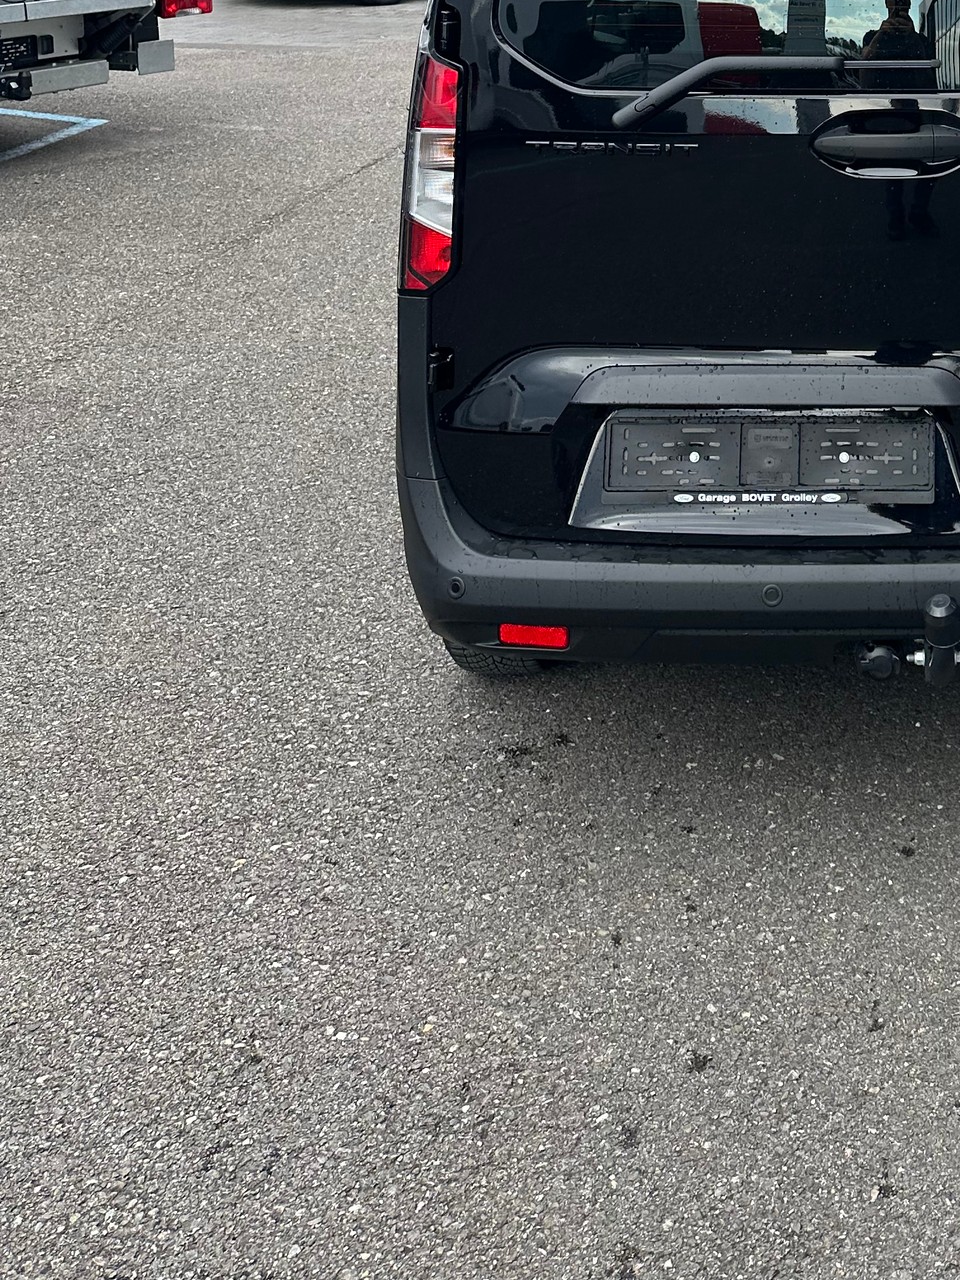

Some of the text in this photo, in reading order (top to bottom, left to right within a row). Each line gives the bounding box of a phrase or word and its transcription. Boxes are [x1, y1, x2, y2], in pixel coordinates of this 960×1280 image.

[525, 140, 699, 157] TRANSIT
[697, 493, 737, 504] Garage
[741, 493, 777, 502] BOVET
[781, 493, 818, 504] Grolley
